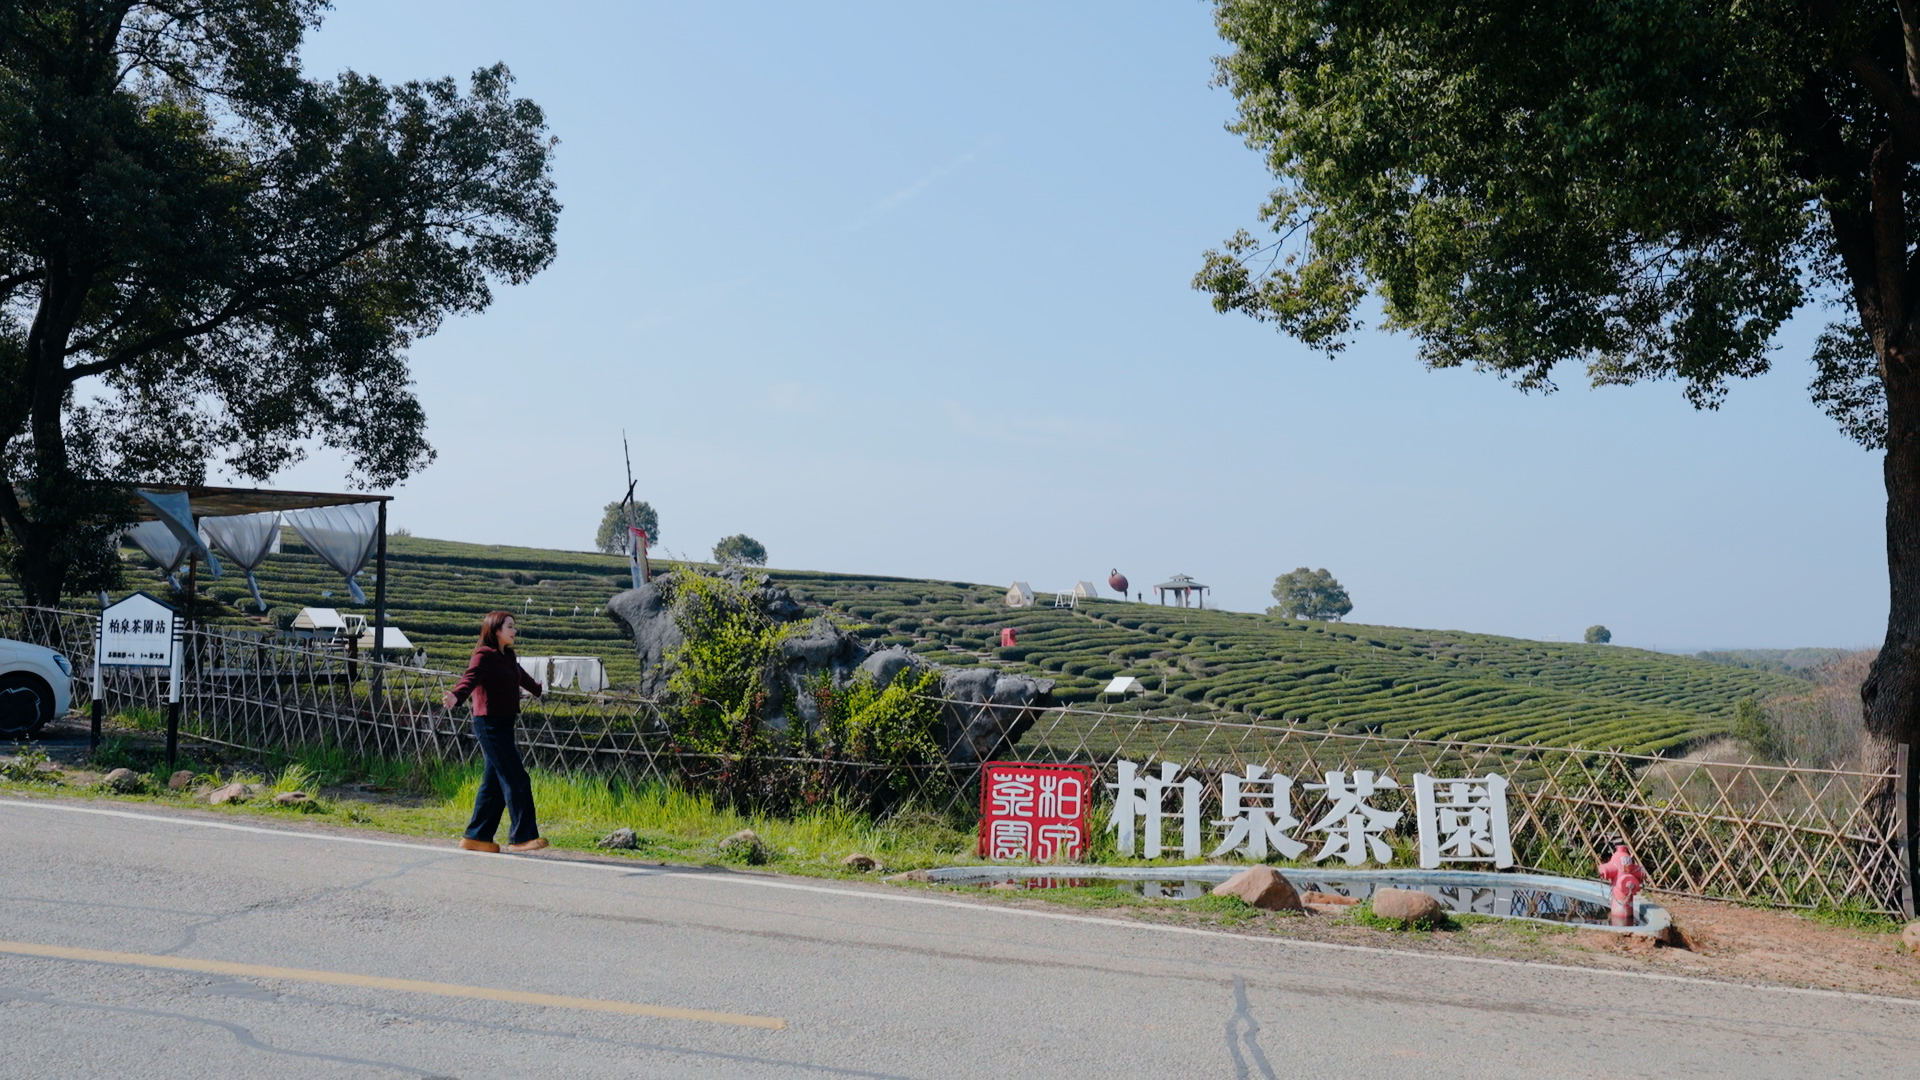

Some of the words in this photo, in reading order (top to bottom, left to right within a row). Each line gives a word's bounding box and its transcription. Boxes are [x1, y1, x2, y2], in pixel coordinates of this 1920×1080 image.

[109, 618, 166, 634] 柏泉茶園站
[1105, 759, 1515, 870] 柏泉茶園
